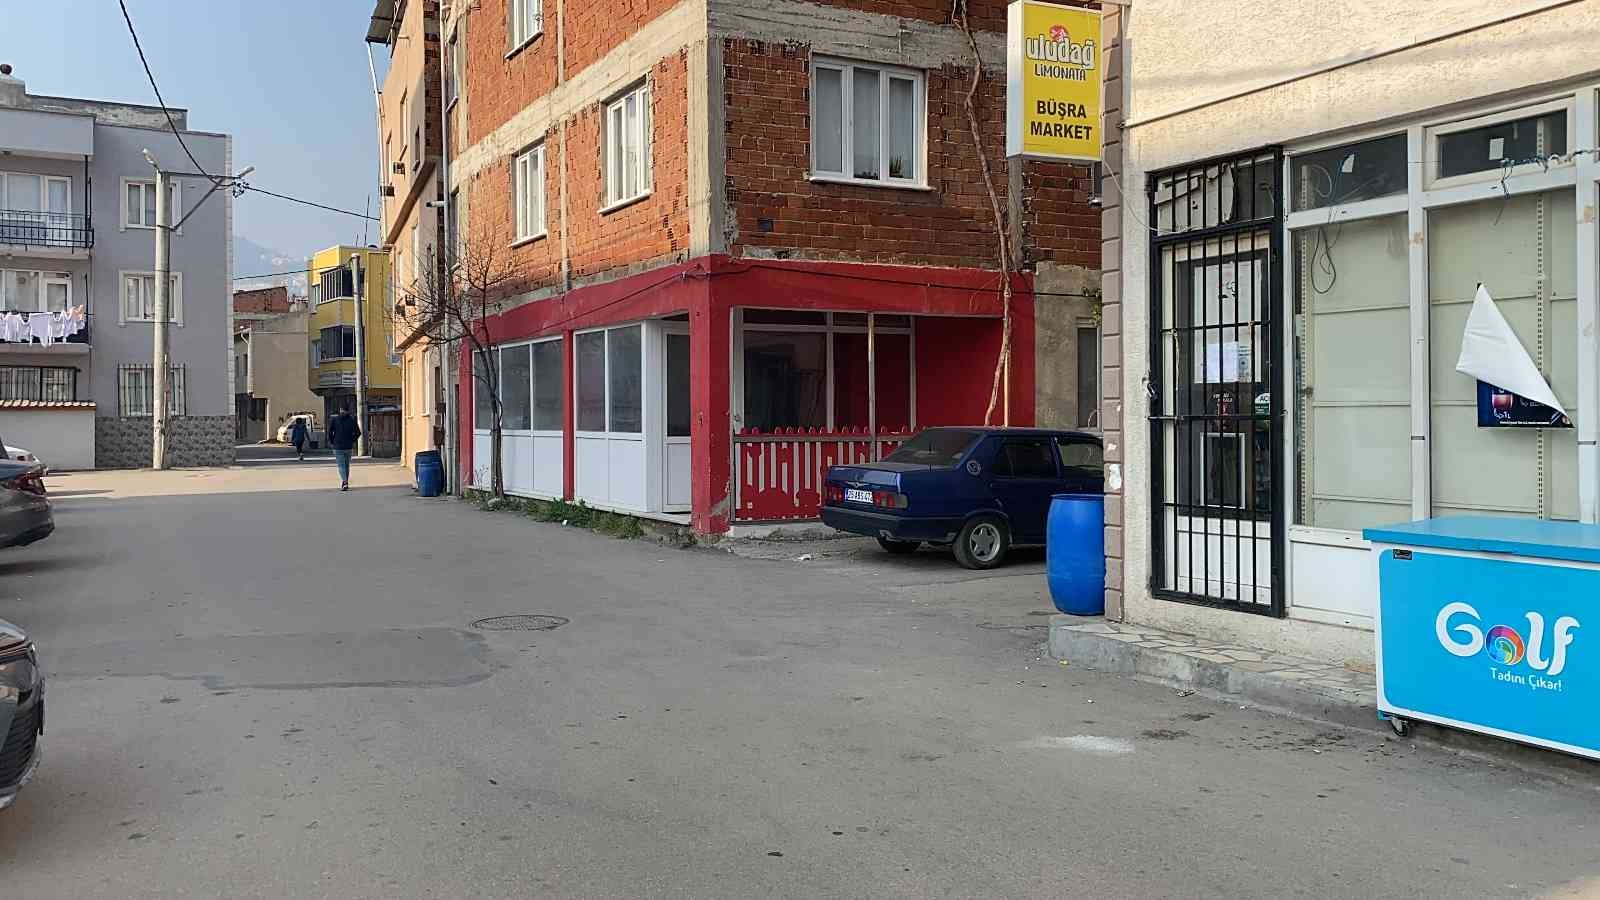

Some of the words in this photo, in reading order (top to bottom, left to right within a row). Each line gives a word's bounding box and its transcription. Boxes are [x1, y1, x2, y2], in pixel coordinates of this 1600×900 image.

[1026, 34, 1096, 70] uludağ
[1037, 99, 1087, 121] BÜŞRA
[1030, 121, 1093, 141] MARKET
[1490, 667, 1525, 685] Tadını
[1528, 674, 1562, 692] Çıkar!
